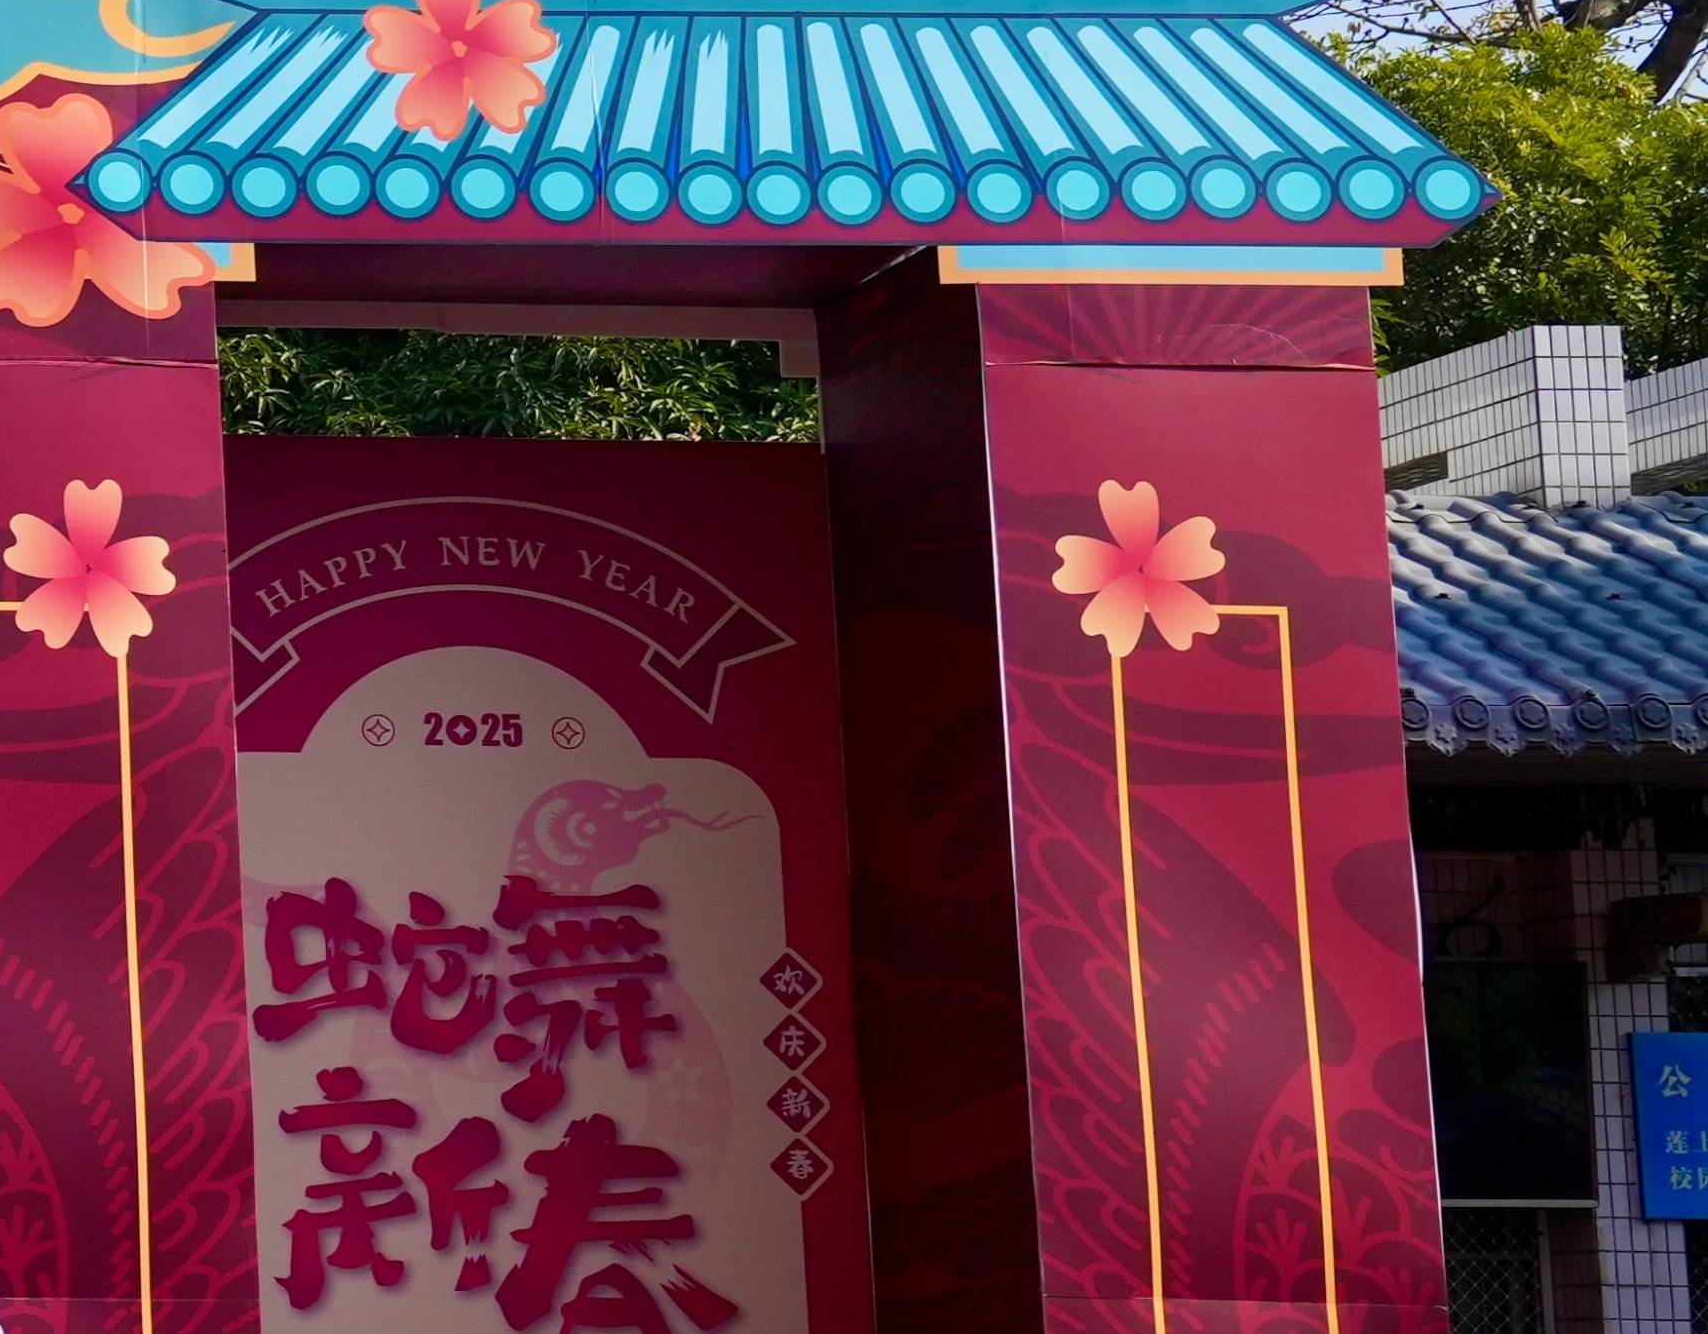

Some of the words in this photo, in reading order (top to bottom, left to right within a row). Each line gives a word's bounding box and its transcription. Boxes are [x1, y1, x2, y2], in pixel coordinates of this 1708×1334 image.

[255, 538, 408, 618] HAPPY
[439, 535, 546, 571] NEW
[576, 549, 697, 625] YEAR
[423, 712, 524, 748] 2025
[773, 967, 814, 1181] 欢庆新春
